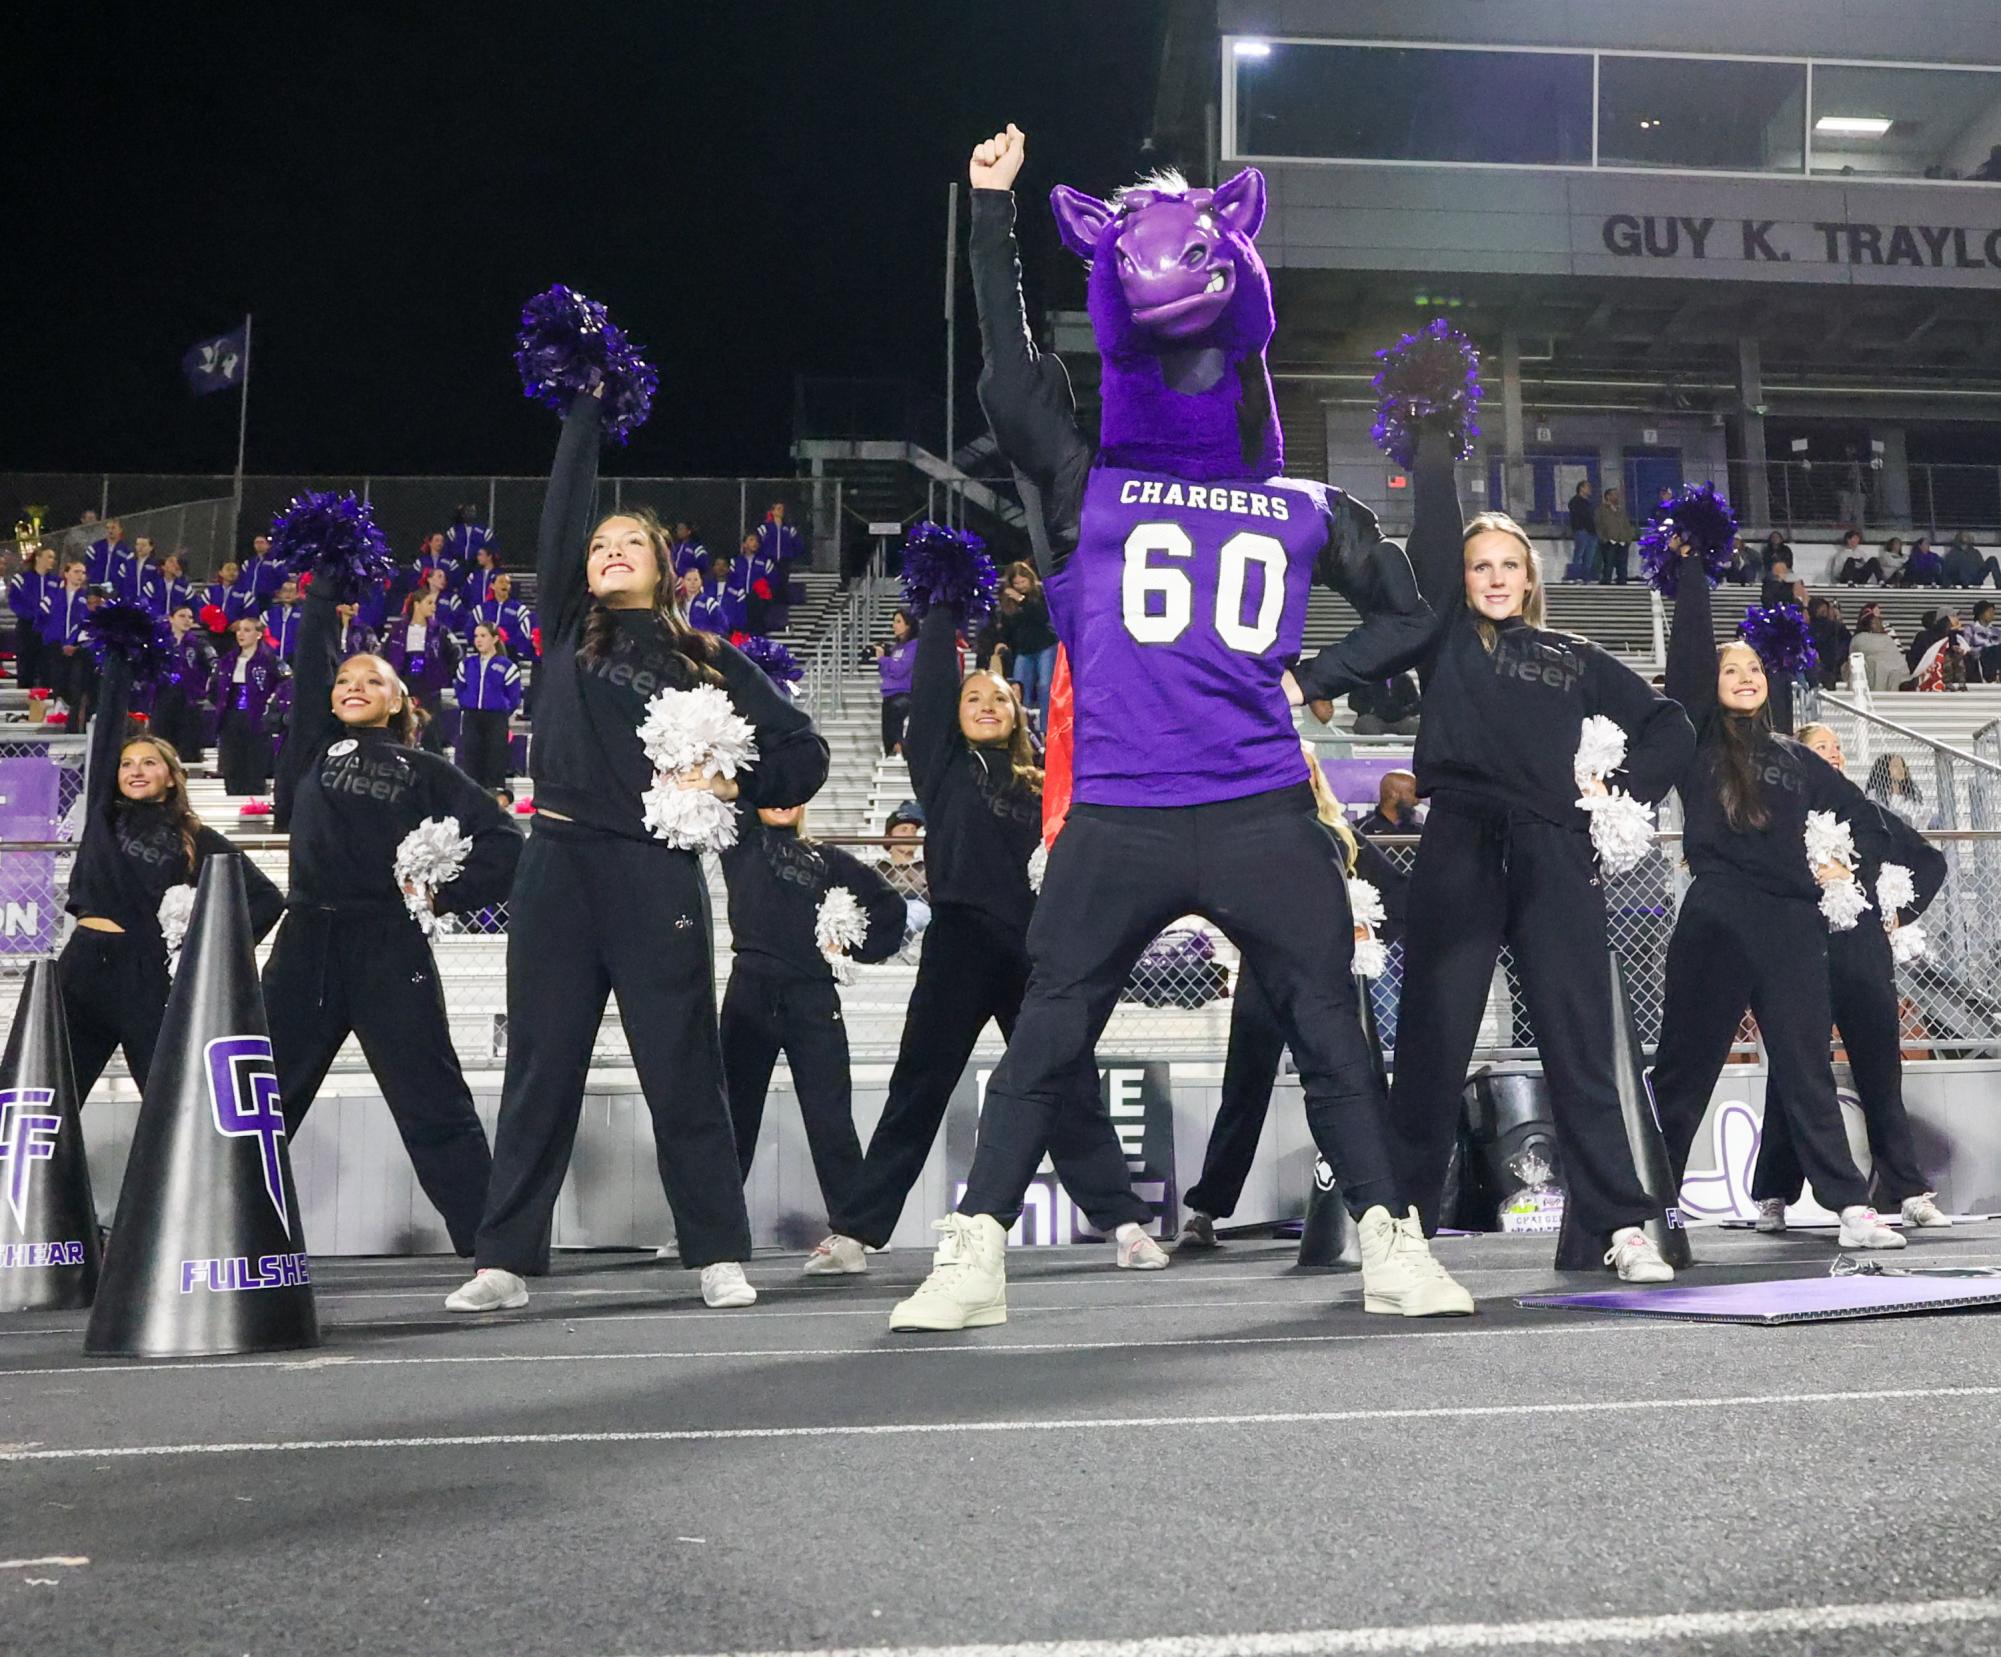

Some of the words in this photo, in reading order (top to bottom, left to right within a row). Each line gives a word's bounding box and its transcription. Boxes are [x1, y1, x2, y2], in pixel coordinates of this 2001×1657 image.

[1602, 214, 1715, 258] GUY
[1742, 220, 1791, 262] K.
[1119, 480, 1290, 521] CHARGERS
[1121, 520, 1290, 657] 60
